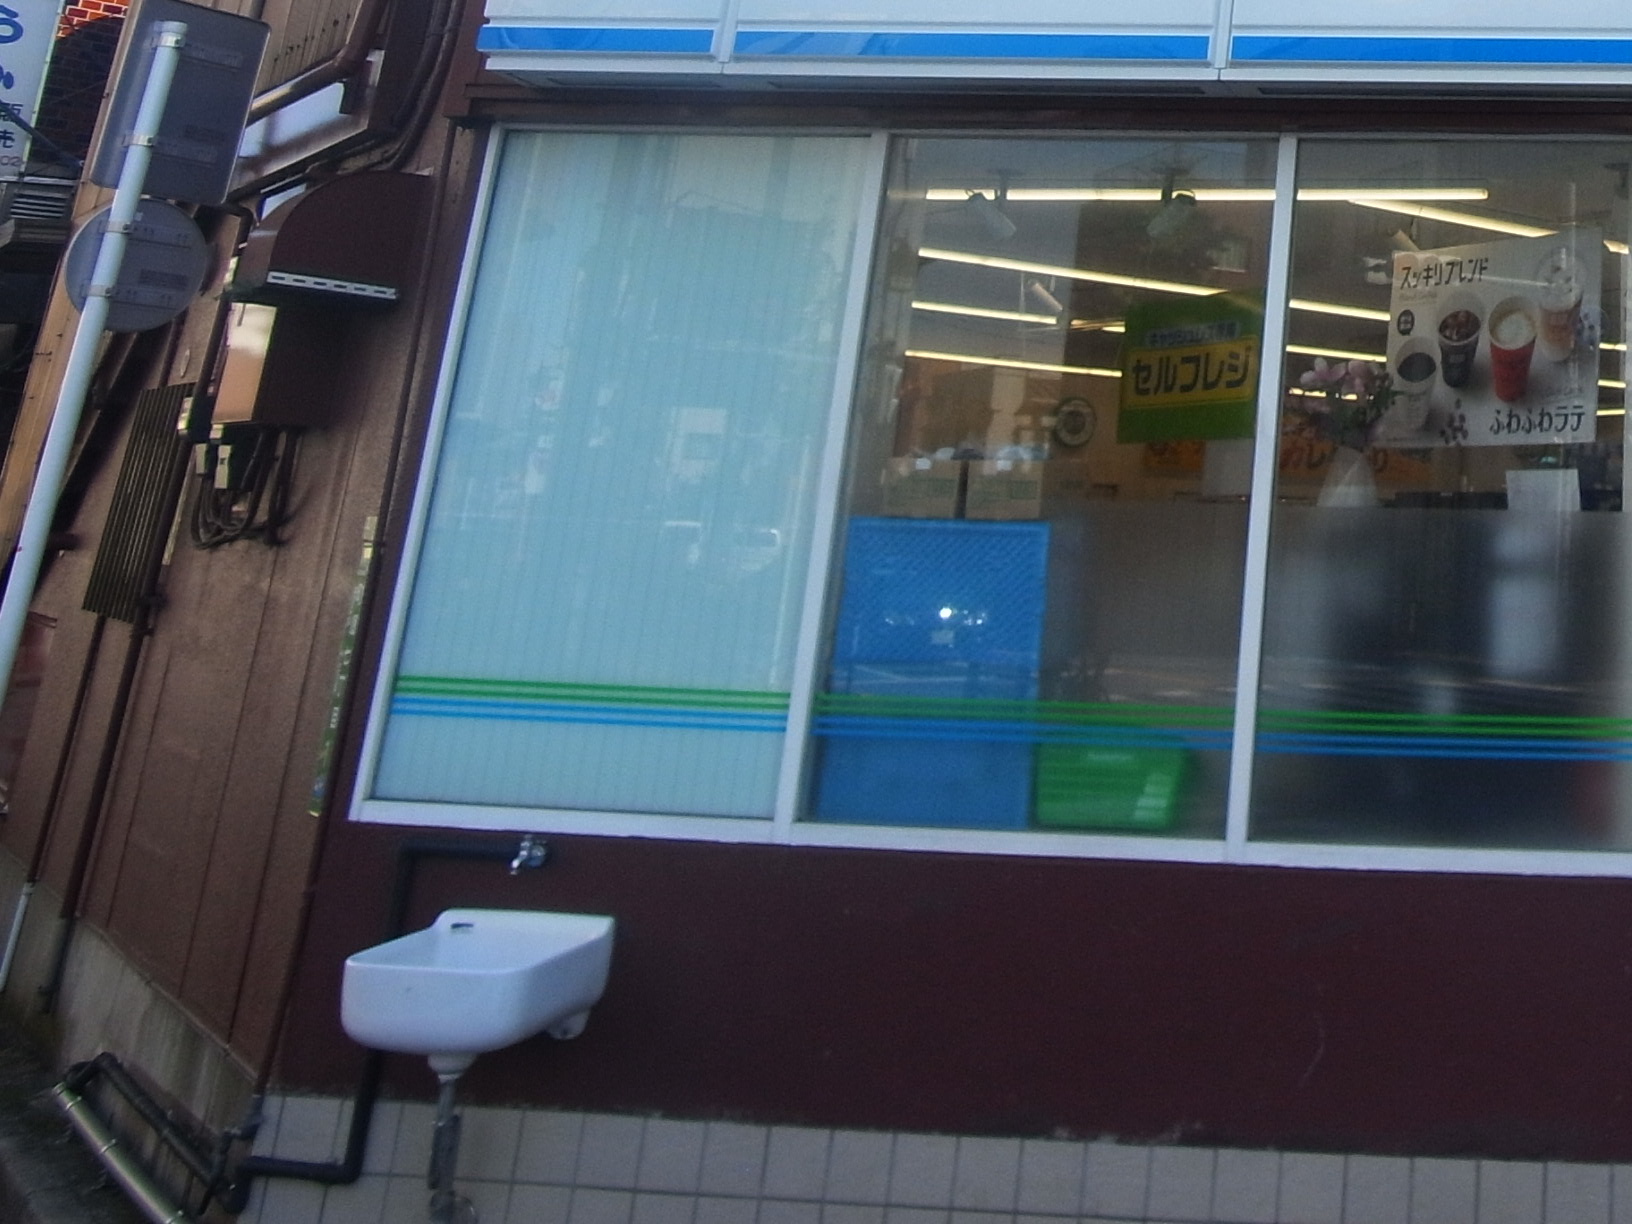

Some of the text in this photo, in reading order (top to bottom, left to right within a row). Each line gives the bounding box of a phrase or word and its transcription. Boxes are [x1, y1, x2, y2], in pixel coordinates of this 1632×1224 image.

[1133, 345, 1253, 396] セルフレジ
[1489, 404, 1586, 435] ふわふわラテ
